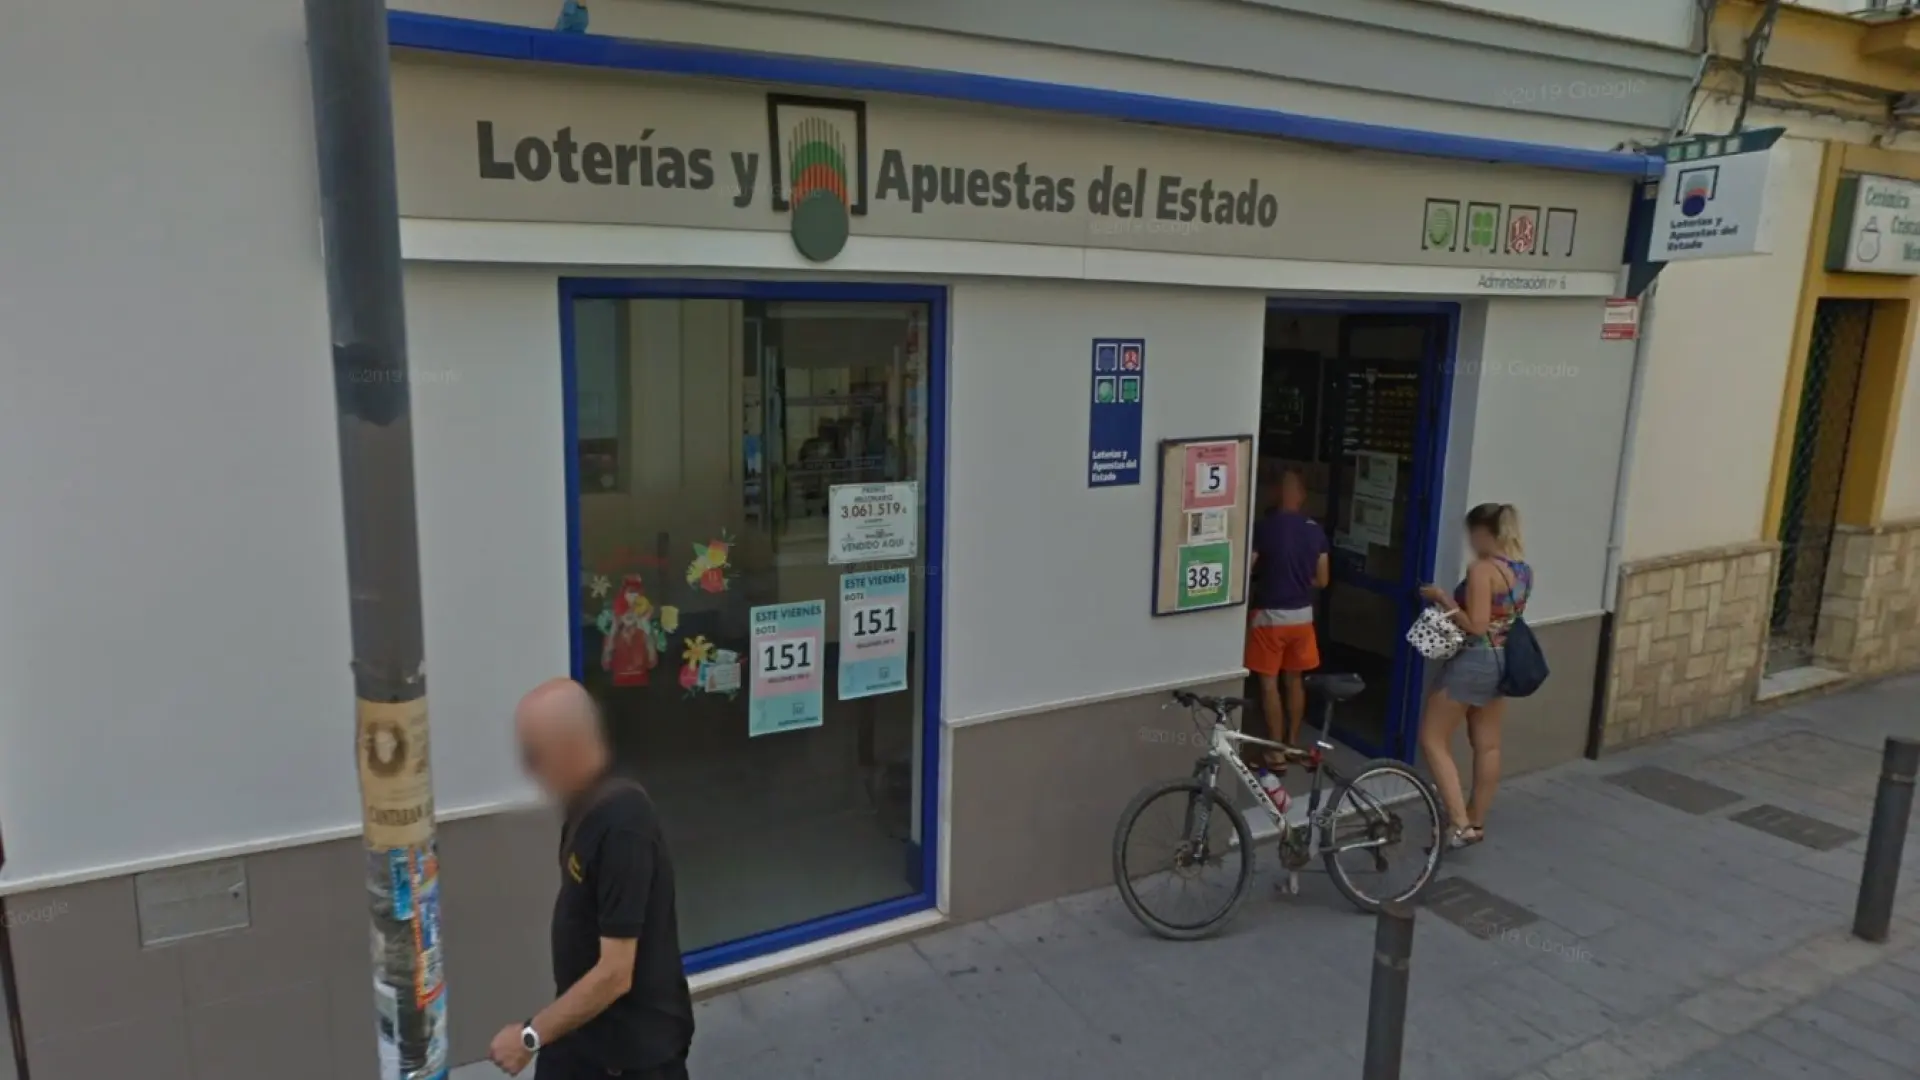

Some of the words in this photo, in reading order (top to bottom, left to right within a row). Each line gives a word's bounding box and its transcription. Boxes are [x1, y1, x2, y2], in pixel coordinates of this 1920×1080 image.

[476, 119, 714, 190] Loterías
[731, 148, 760, 209] y
[874, 148, 1077, 219] Apuestas
[1087, 163, 1147, 219] del
[1155, 174, 1280, 229] Estado
[1208, 466, 1221, 490] 5
[841, 541, 880, 553] VENDIDO
[844, 577, 866, 590] ESTE
[868, 573, 907, 587] VIERNES
[1187, 566, 1222, 590] 38.5
[844, 593, 865, 602] BOTE
[755, 610, 778, 623] ESTE
[780, 605, 822, 620] VIERNES
[853, 606, 898, 637] 151
[755, 625, 777, 635] BOTE
[763, 641, 812, 672] 151
